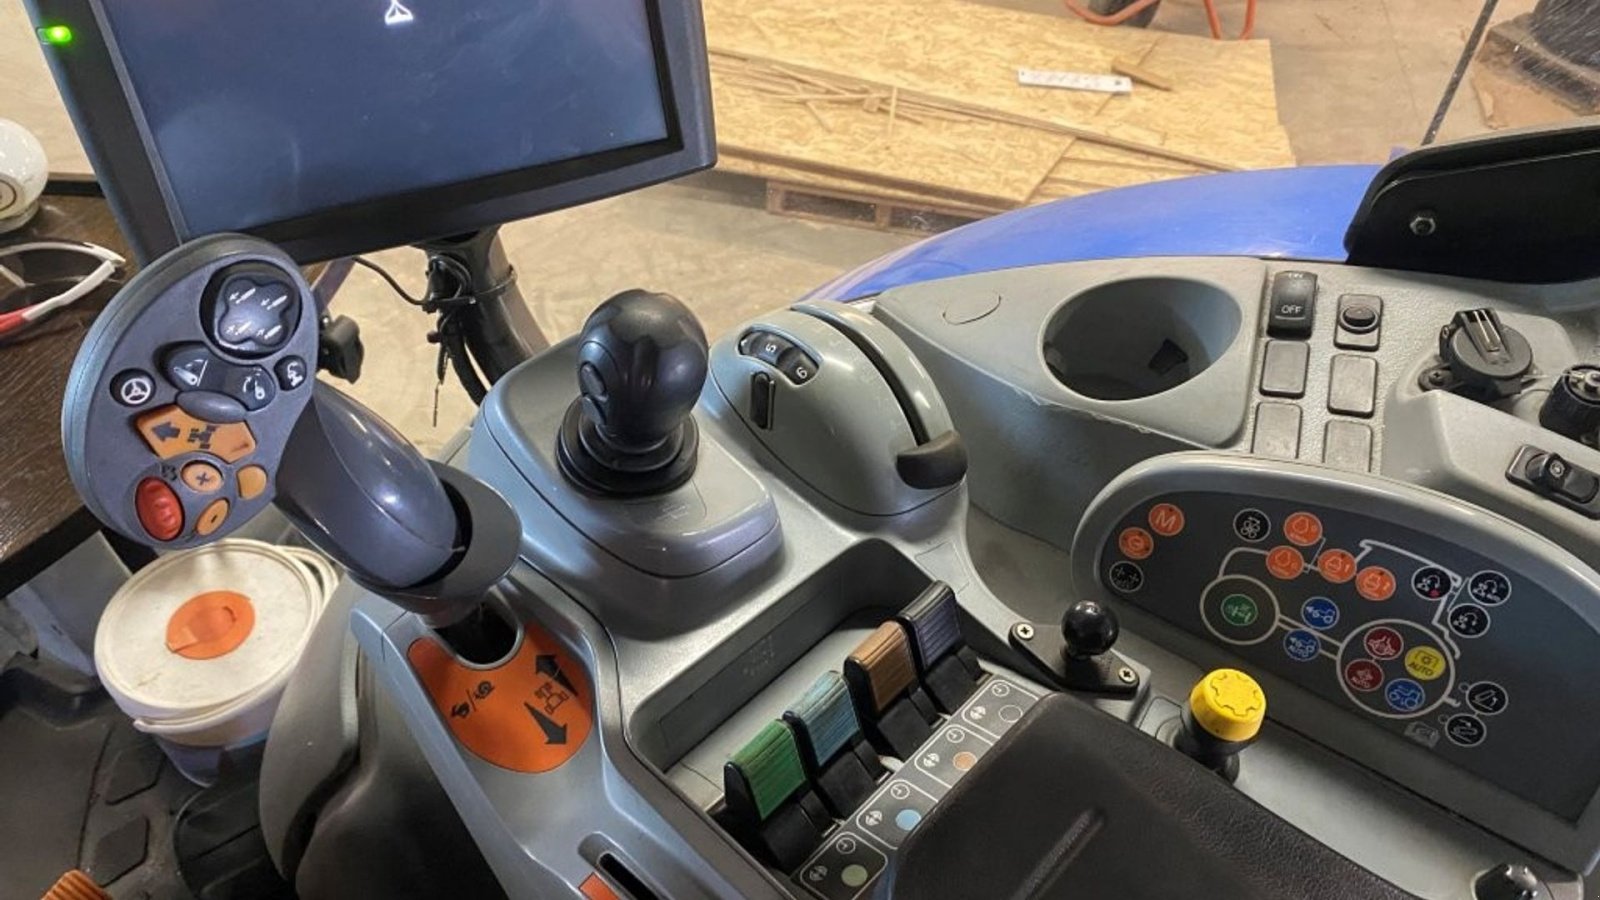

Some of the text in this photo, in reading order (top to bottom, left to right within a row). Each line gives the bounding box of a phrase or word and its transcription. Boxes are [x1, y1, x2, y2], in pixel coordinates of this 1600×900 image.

[1281, 304, 1303, 314] OFF
[1155, 510, 1177, 532] M
[1407, 661, 1434, 678] AUTO
